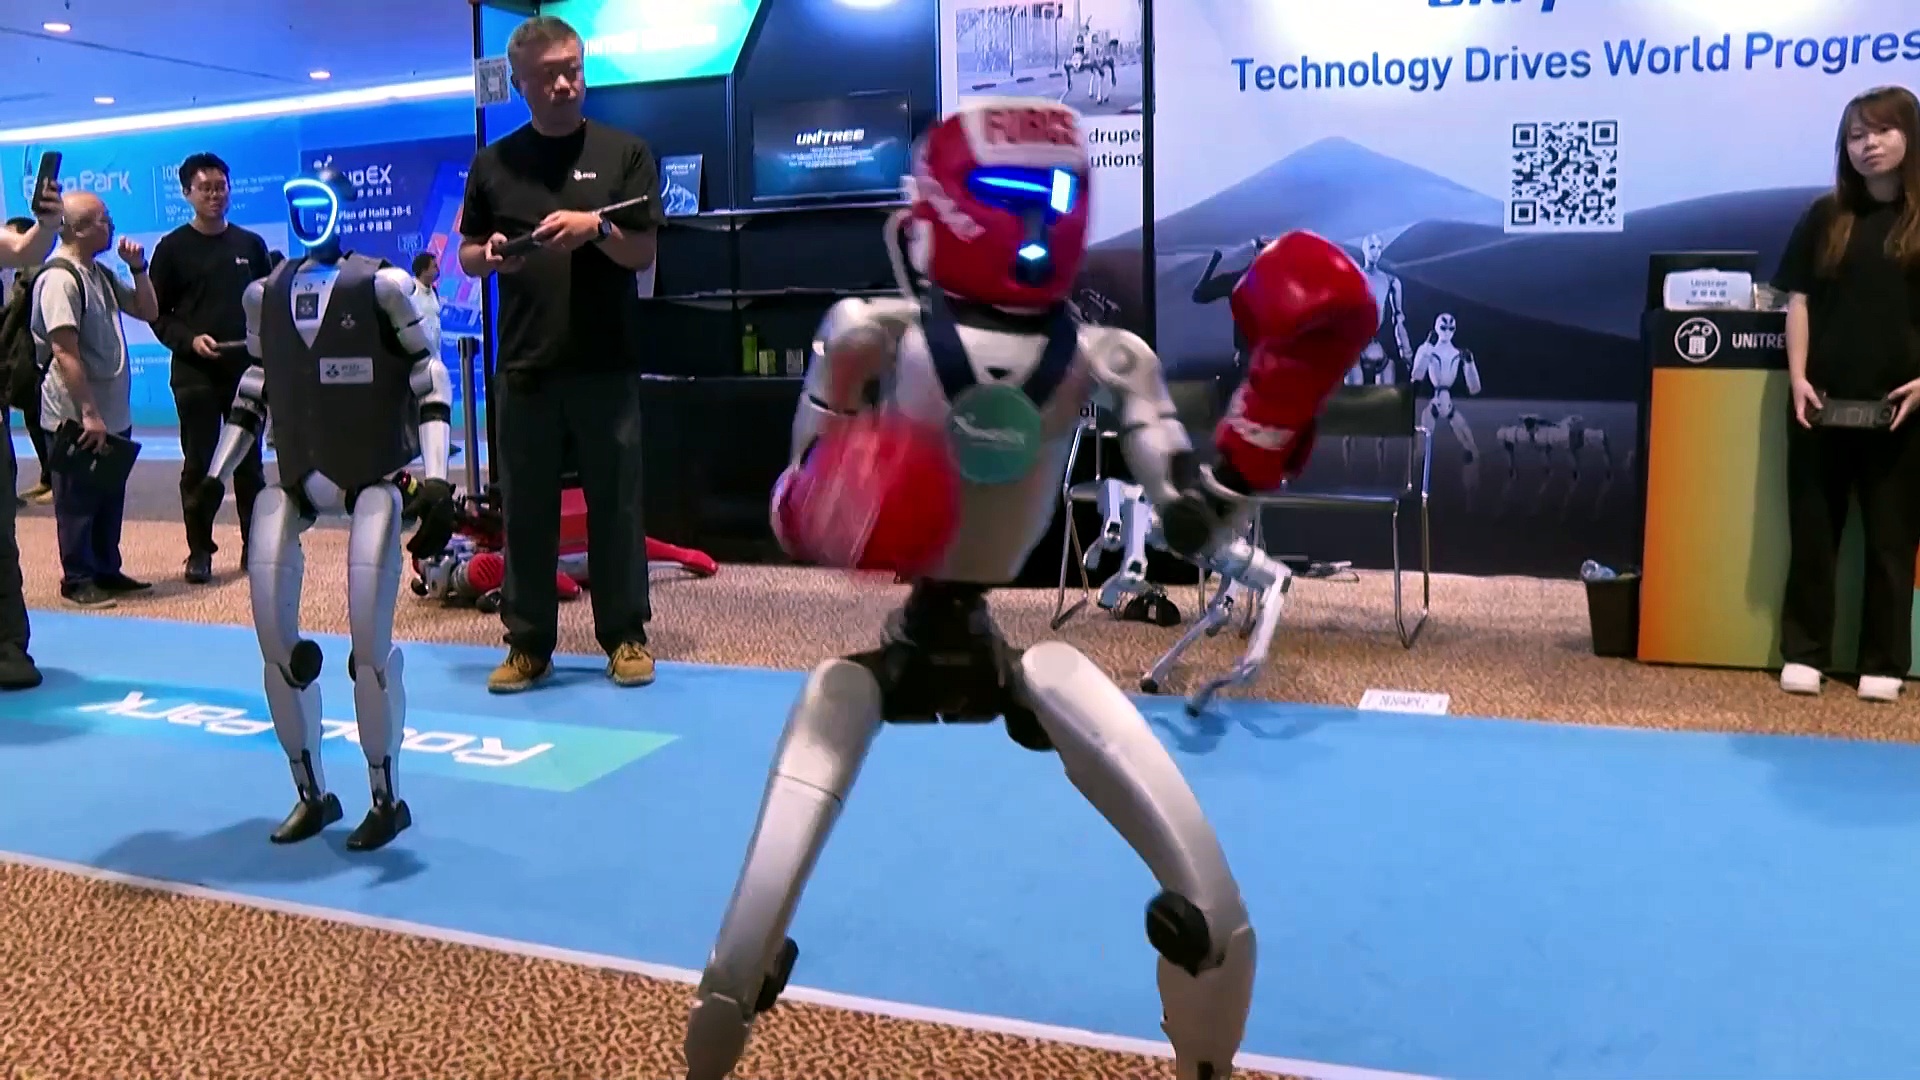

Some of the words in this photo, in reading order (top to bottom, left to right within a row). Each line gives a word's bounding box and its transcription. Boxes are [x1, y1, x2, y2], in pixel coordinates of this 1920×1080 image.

[1231, 51, 1453, 92] Technology
[1465, 45, 1592, 83] Drives
[1603, 33, 1731, 76] World
[1744, 29, 1920, 74] Progres
[1731, 332, 1786, 349] UNITRE
